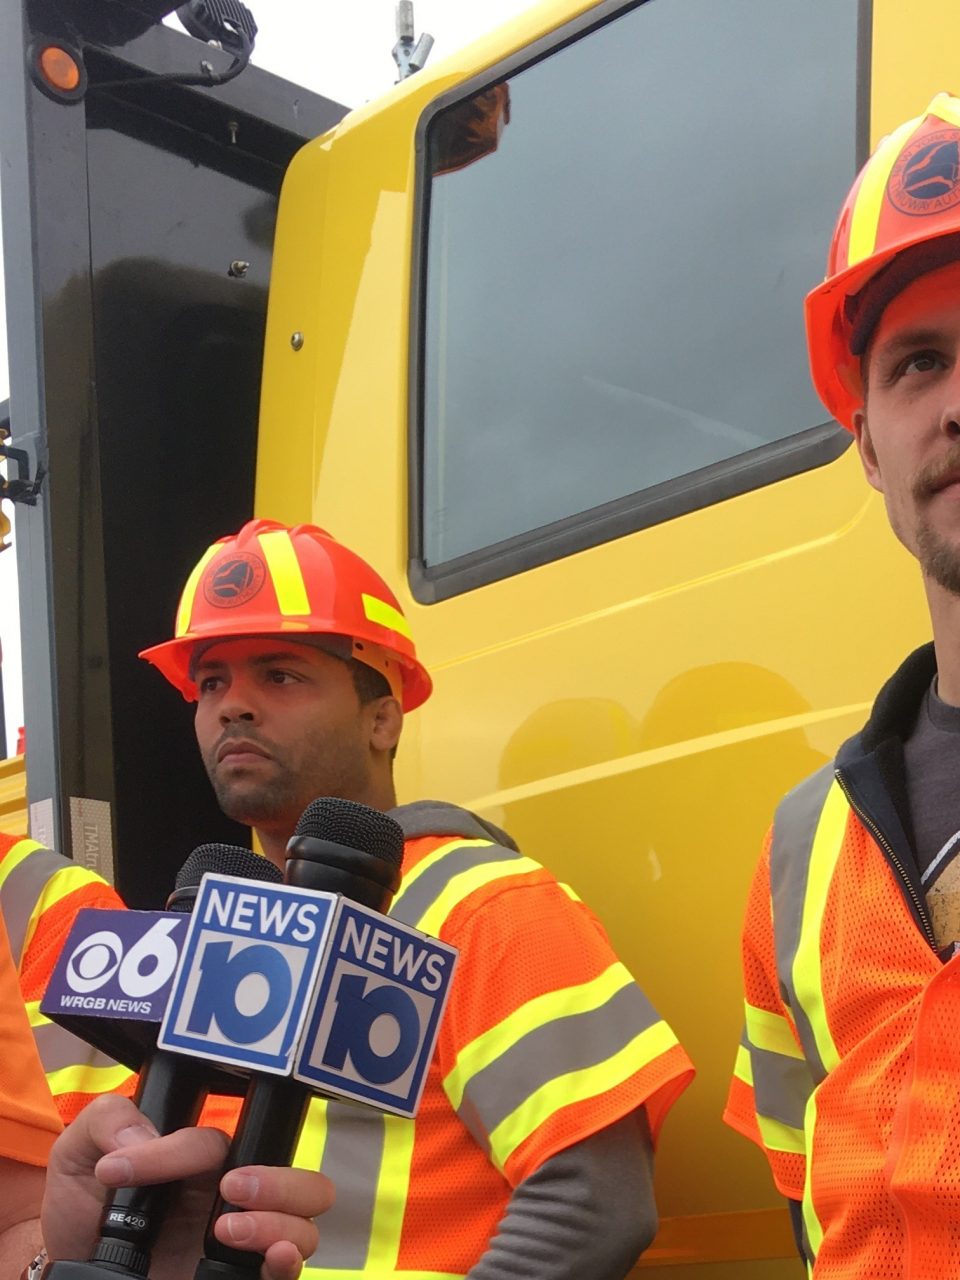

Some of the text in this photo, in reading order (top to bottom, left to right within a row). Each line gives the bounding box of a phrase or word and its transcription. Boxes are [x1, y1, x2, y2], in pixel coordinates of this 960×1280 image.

[203, 887, 320, 942] NEWS
[339, 916, 446, 992] NEWS
[60, 995, 152, 1014] WRGB NEWS
[186, 940, 293, 1044] 10
[322, 973, 421, 1085] 10
[109, 1212, 146, 1228] RE420
